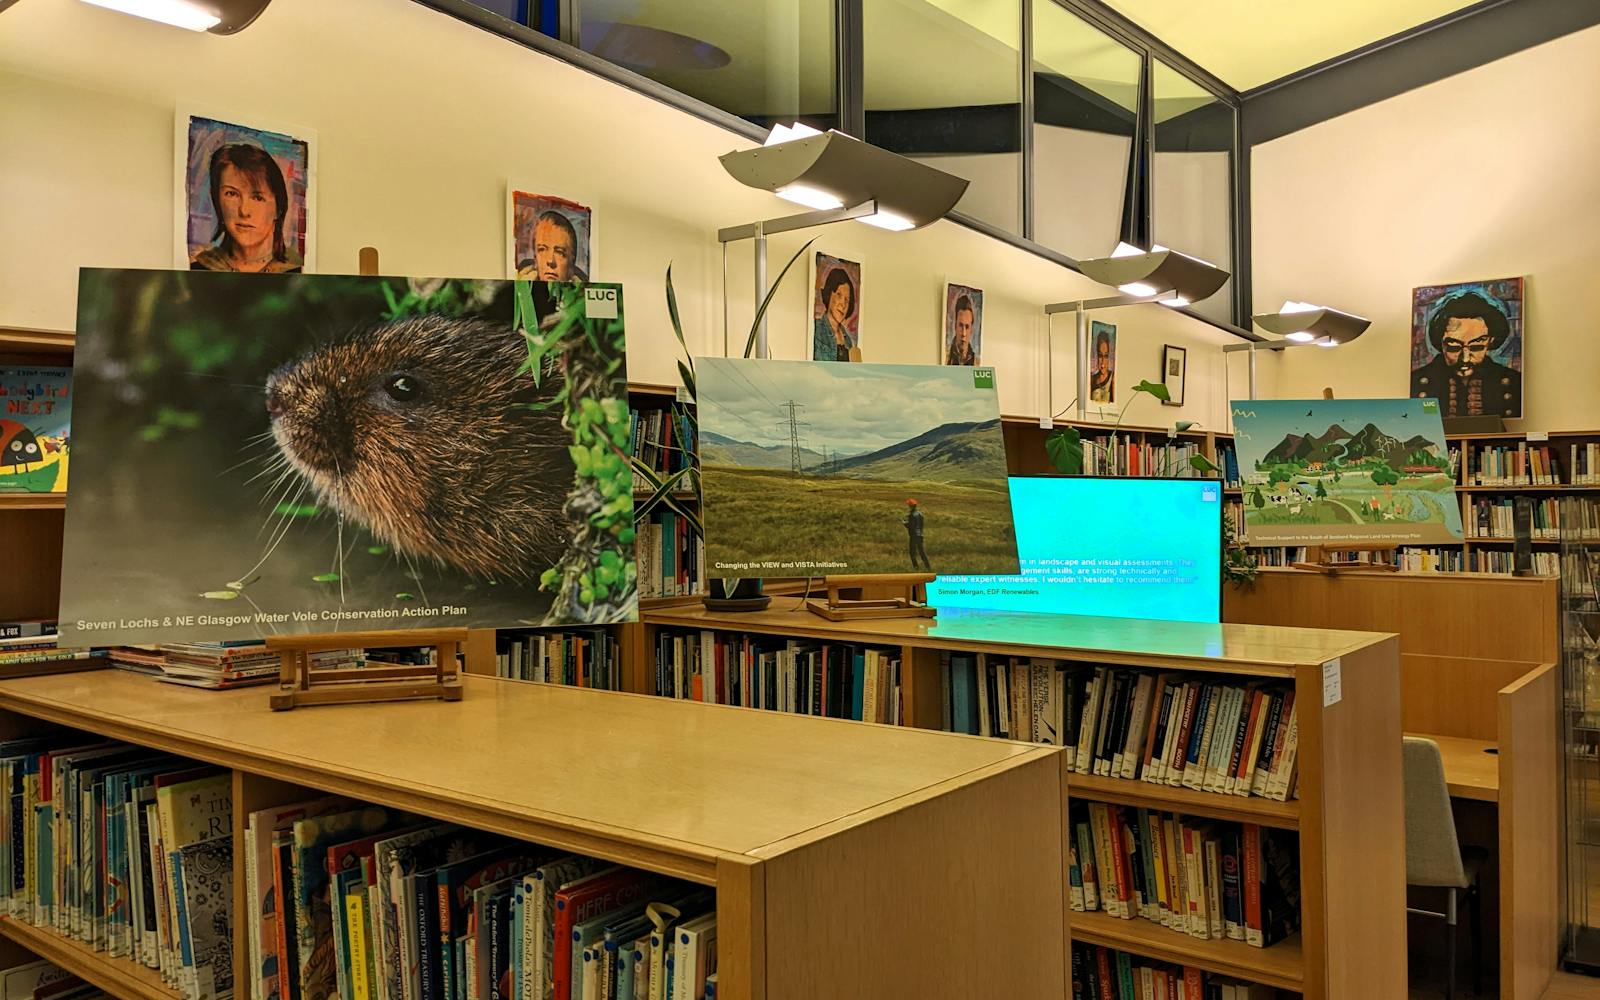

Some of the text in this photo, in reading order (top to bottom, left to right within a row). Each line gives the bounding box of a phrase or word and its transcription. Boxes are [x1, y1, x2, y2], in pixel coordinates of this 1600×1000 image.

[587, 290, 615, 301] LUC
[1038, 559, 1079, 567] landscape
[1092, 568, 1118, 576] strong
[1119, 567, 1161, 576] technically
[970, 576, 996, 584] expert
[1125, 576, 1173, 584] recommend
[76, 605, 467, 631] Seven Lochs & NE Glasgow Water Vole Conservation Action Plan
[7, 627, 19, 636] FOX
[1174, 747, 1183, 769] BOOTH
[417, 890, 425, 906] THE
[524, 894, 533, 923] Tomie
[418, 908, 427, 947] OXFORD
[420, 949, 430, 993] TREASURY
